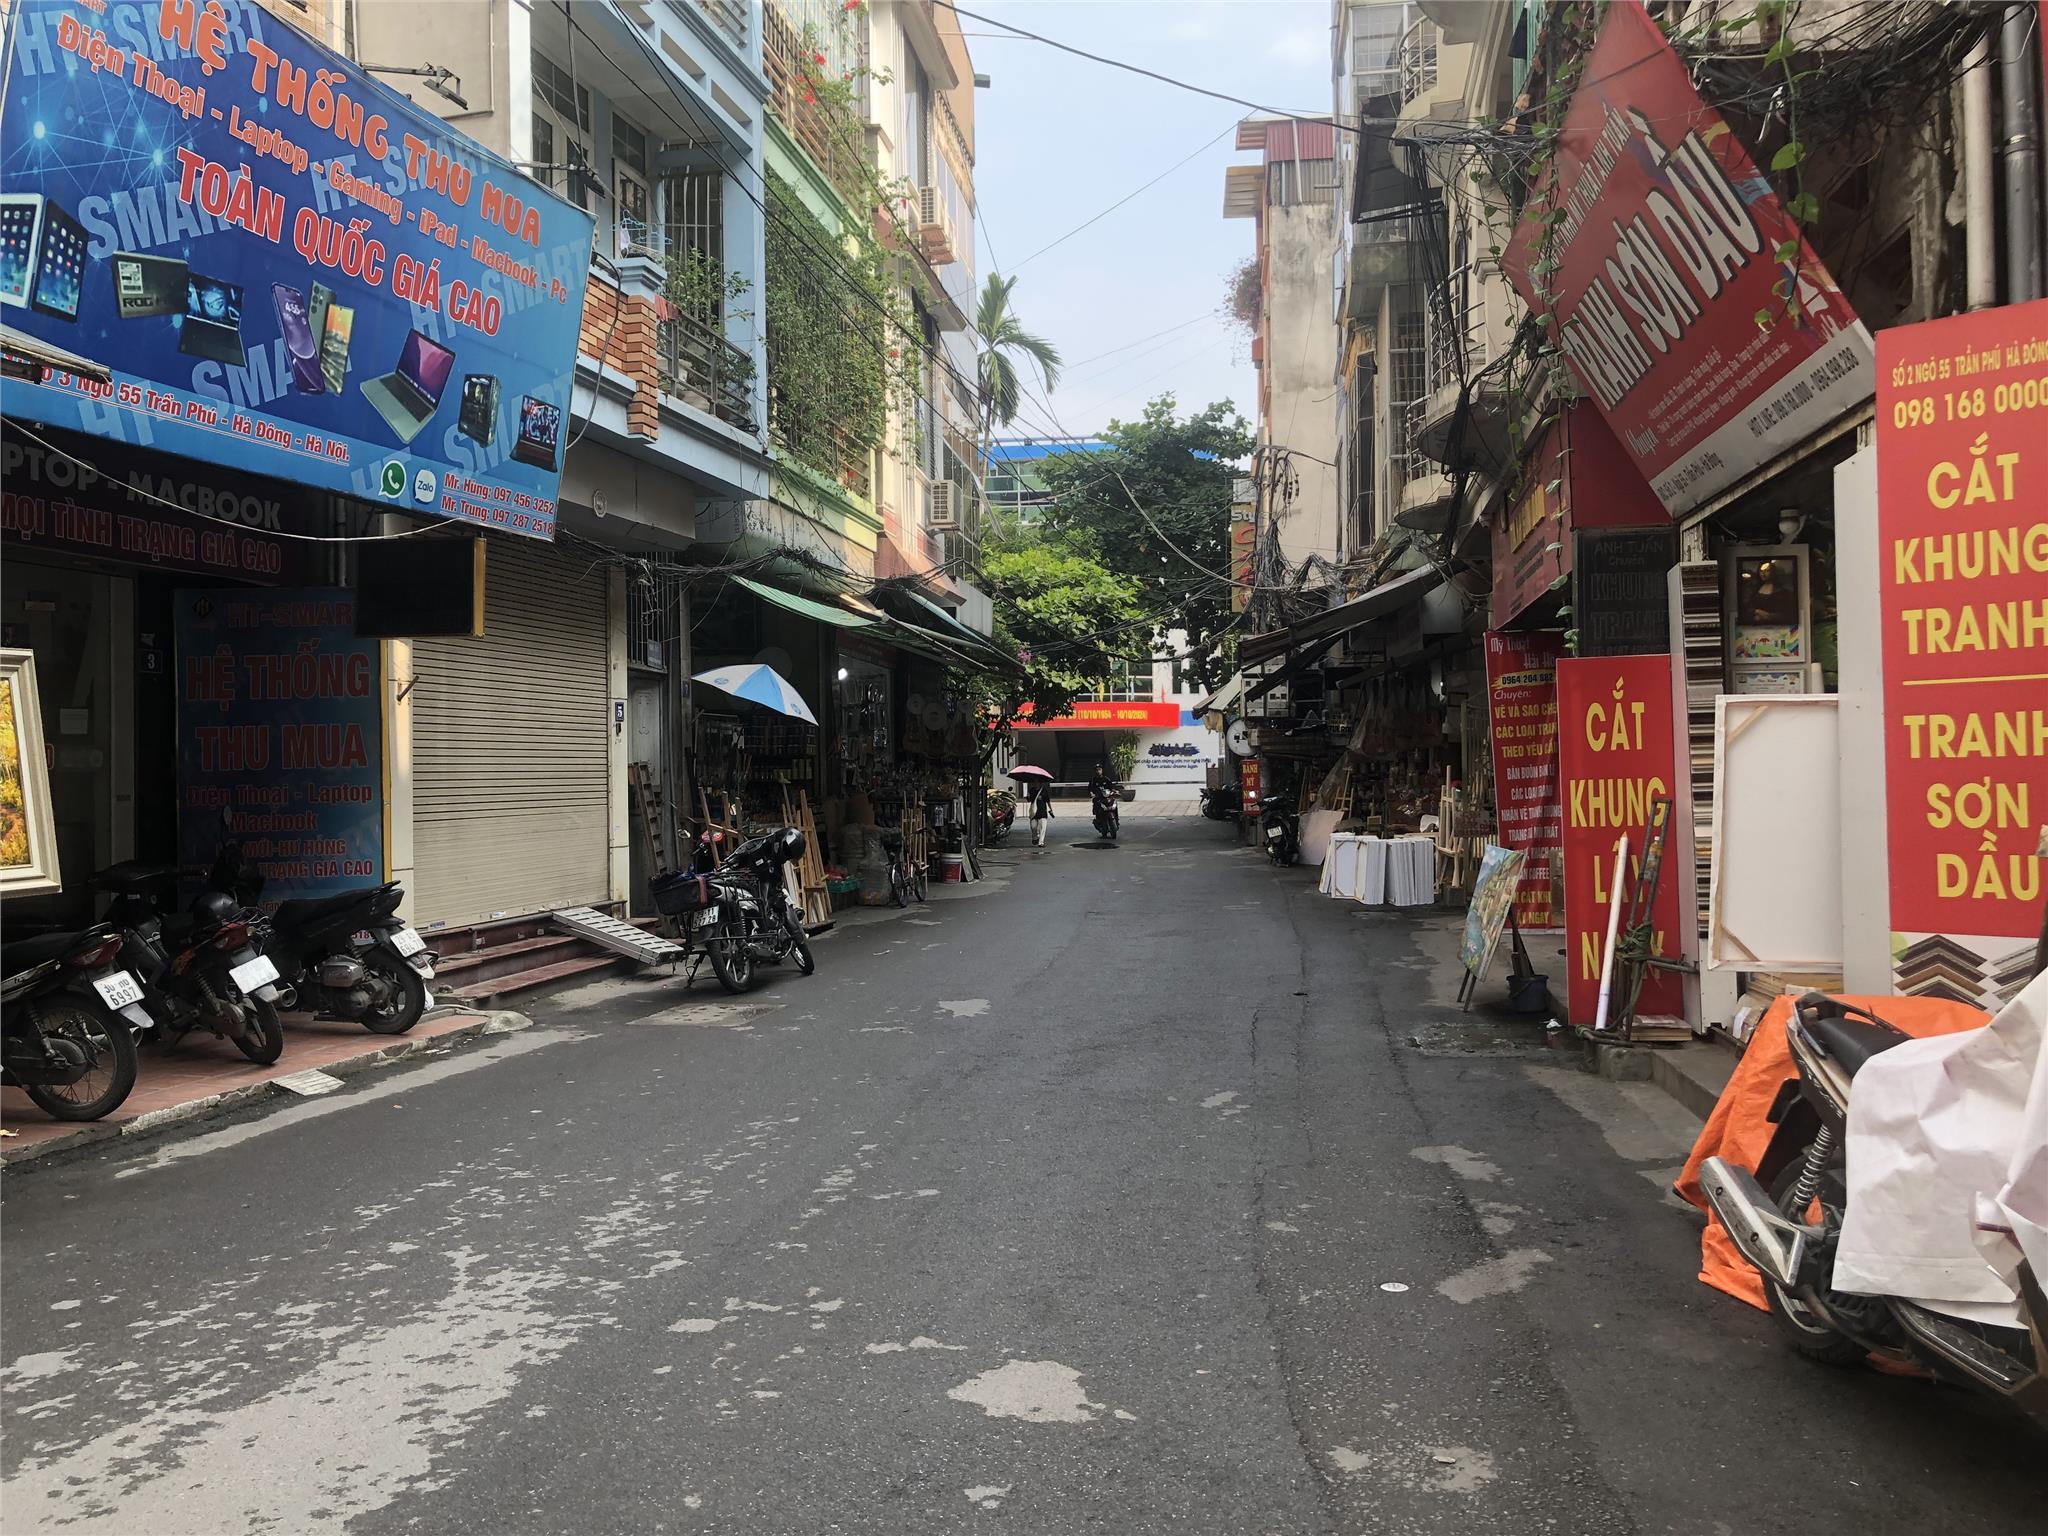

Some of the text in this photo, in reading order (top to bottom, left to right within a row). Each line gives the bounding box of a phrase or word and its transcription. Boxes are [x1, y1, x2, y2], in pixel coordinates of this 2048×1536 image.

[159, 0, 540, 248] HỆ THỐNG THU MUA
[1602, 102, 1631, 156] TUẤN
[57, 13, 567, 305] Điện Thoại Laptop Gaming iPad Macbook Pc
[1591, 139, 1616, 182] ANH
[1575, 161, 1605, 211] THUẬT
[1627, 106, 1761, 300] DẦU
[177, 146, 501, 336] TOÀN QUỐC GIÁ CAO
[1605, 214, 1700, 354] SƠN
[1562, 277, 1654, 411] TRANH
[1892, 358, 1905, 388] SỐ
[1907, 365, 1914, 384] 2
[1915, 358, 1936, 384] NGÕ
[1939, 359, 1950, 379] 55
[1955, 345, 1979, 377] TRẦN
[1982, 344, 2001, 373] PHÚ
[2006, 340, 2021, 369] HÀ
[58, 373, 71, 387] 3
[118, 384, 141, 406] 55
[147, 390, 182, 417] Trần
[186, 399, 217, 427] Phú
[232, 411, 251, 435] Hà
[255, 420, 292, 450] Đông
[305, 433, 322, 454] Hà
[1894, 377, 2048, 429] 098 168 0000
[417, 480, 434, 493] Zalo
[444, 473, 461, 489] Mr.
[494, 487, 512, 503] 097
[514, 493, 531, 508] 456
[533, 498, 554, 515] 3252
[1927, 431, 2020, 509] CẮT
[127, 471, 281, 530] MACBOOK
[441, 496, 457, 512] Mr.
[460, 500, 491, 521] Trung:
[492, 509, 510, 523] 097
[512, 514, 530, 529] 287
[51, 497, 112, 547] TÌNH
[118, 516, 196, 561] TRẠNG
[201, 531, 237, 568] GIÁ
[242, 538, 282, 574] CAO
[1894, 523, 2048, 585] KHUNG
[227, 602, 353, 628] HT-SMAR
[1902, 599, 2048, 654] TRANH
[148, 653, 155, 669] 3
[186, 638, 370, 711] HỆ THỐNG
[1585, 676, 1646, 751] CẮT
[1903, 710, 2048, 758] TRANH
[195, 723, 368, 771] THU MUA
[1502, 745, 1524, 758] THEO
[309, 783, 372, 805] Laptop
[1570, 777, 1667, 828] KHUNG
[1926, 776, 2029, 829] SƠN
[314, 859, 339, 877] GIÁ
[343, 859, 373, 876] CAO
[1937, 829, 2040, 900] DẦU
[109, 986, 137, 1006] 6997
